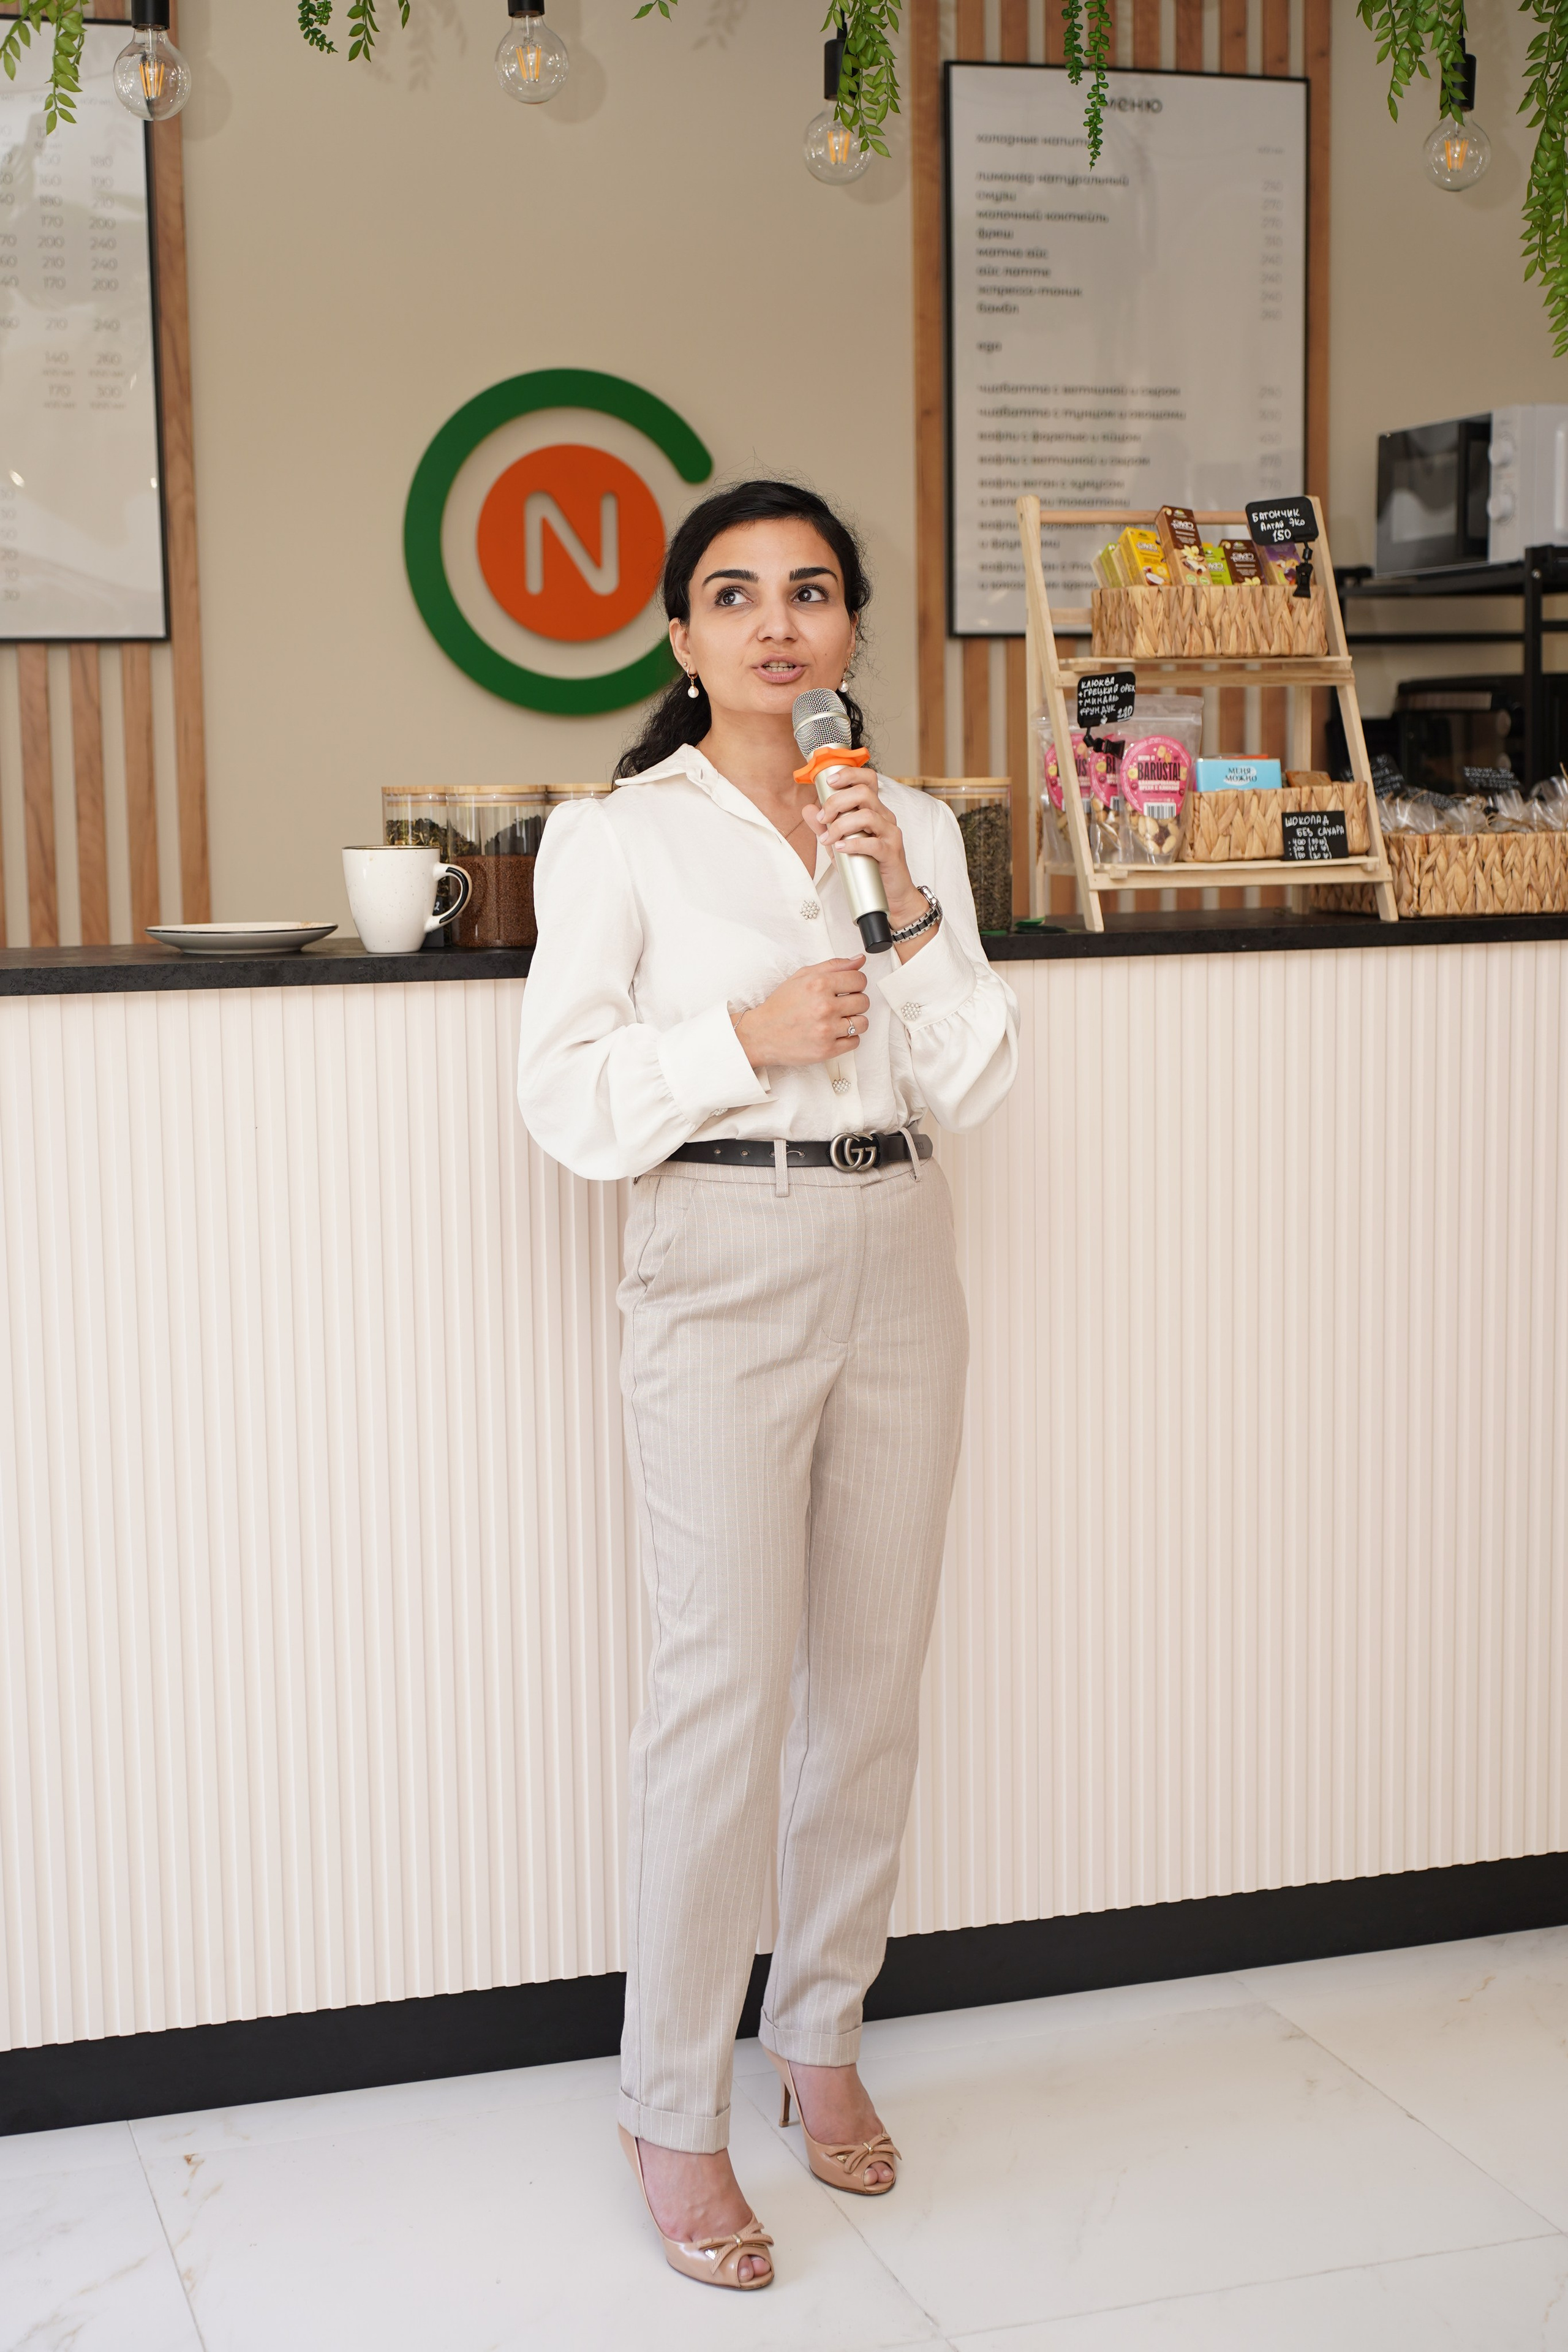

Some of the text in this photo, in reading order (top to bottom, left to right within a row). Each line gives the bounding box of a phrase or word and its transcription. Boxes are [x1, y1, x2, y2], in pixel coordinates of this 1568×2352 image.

[89, 216, 116, 230] 200
[37, 235, 65, 249] 200
[90, 236, 117, 251] 240
[91, 257, 118, 271] 240
[92, 277, 119, 292] 200
[93, 317, 121, 333] 240
[1251, 508, 1300, 523] БАТОНЧИК
[1272, 528, 1292, 543] 150
[524, 491, 620, 597] N
[1080, 676, 1115, 690] КЛЮКВА
[1120, 683, 1136, 693] ОРЕХ
[1137, 758, 1181, 781] BARÚSTA!
[1225, 774, 1257, 783] МОЖНО
[1285, 814, 1329, 827] ШОКОЛАД
[1296, 824, 1344, 837] БЕЗ САХАРА
